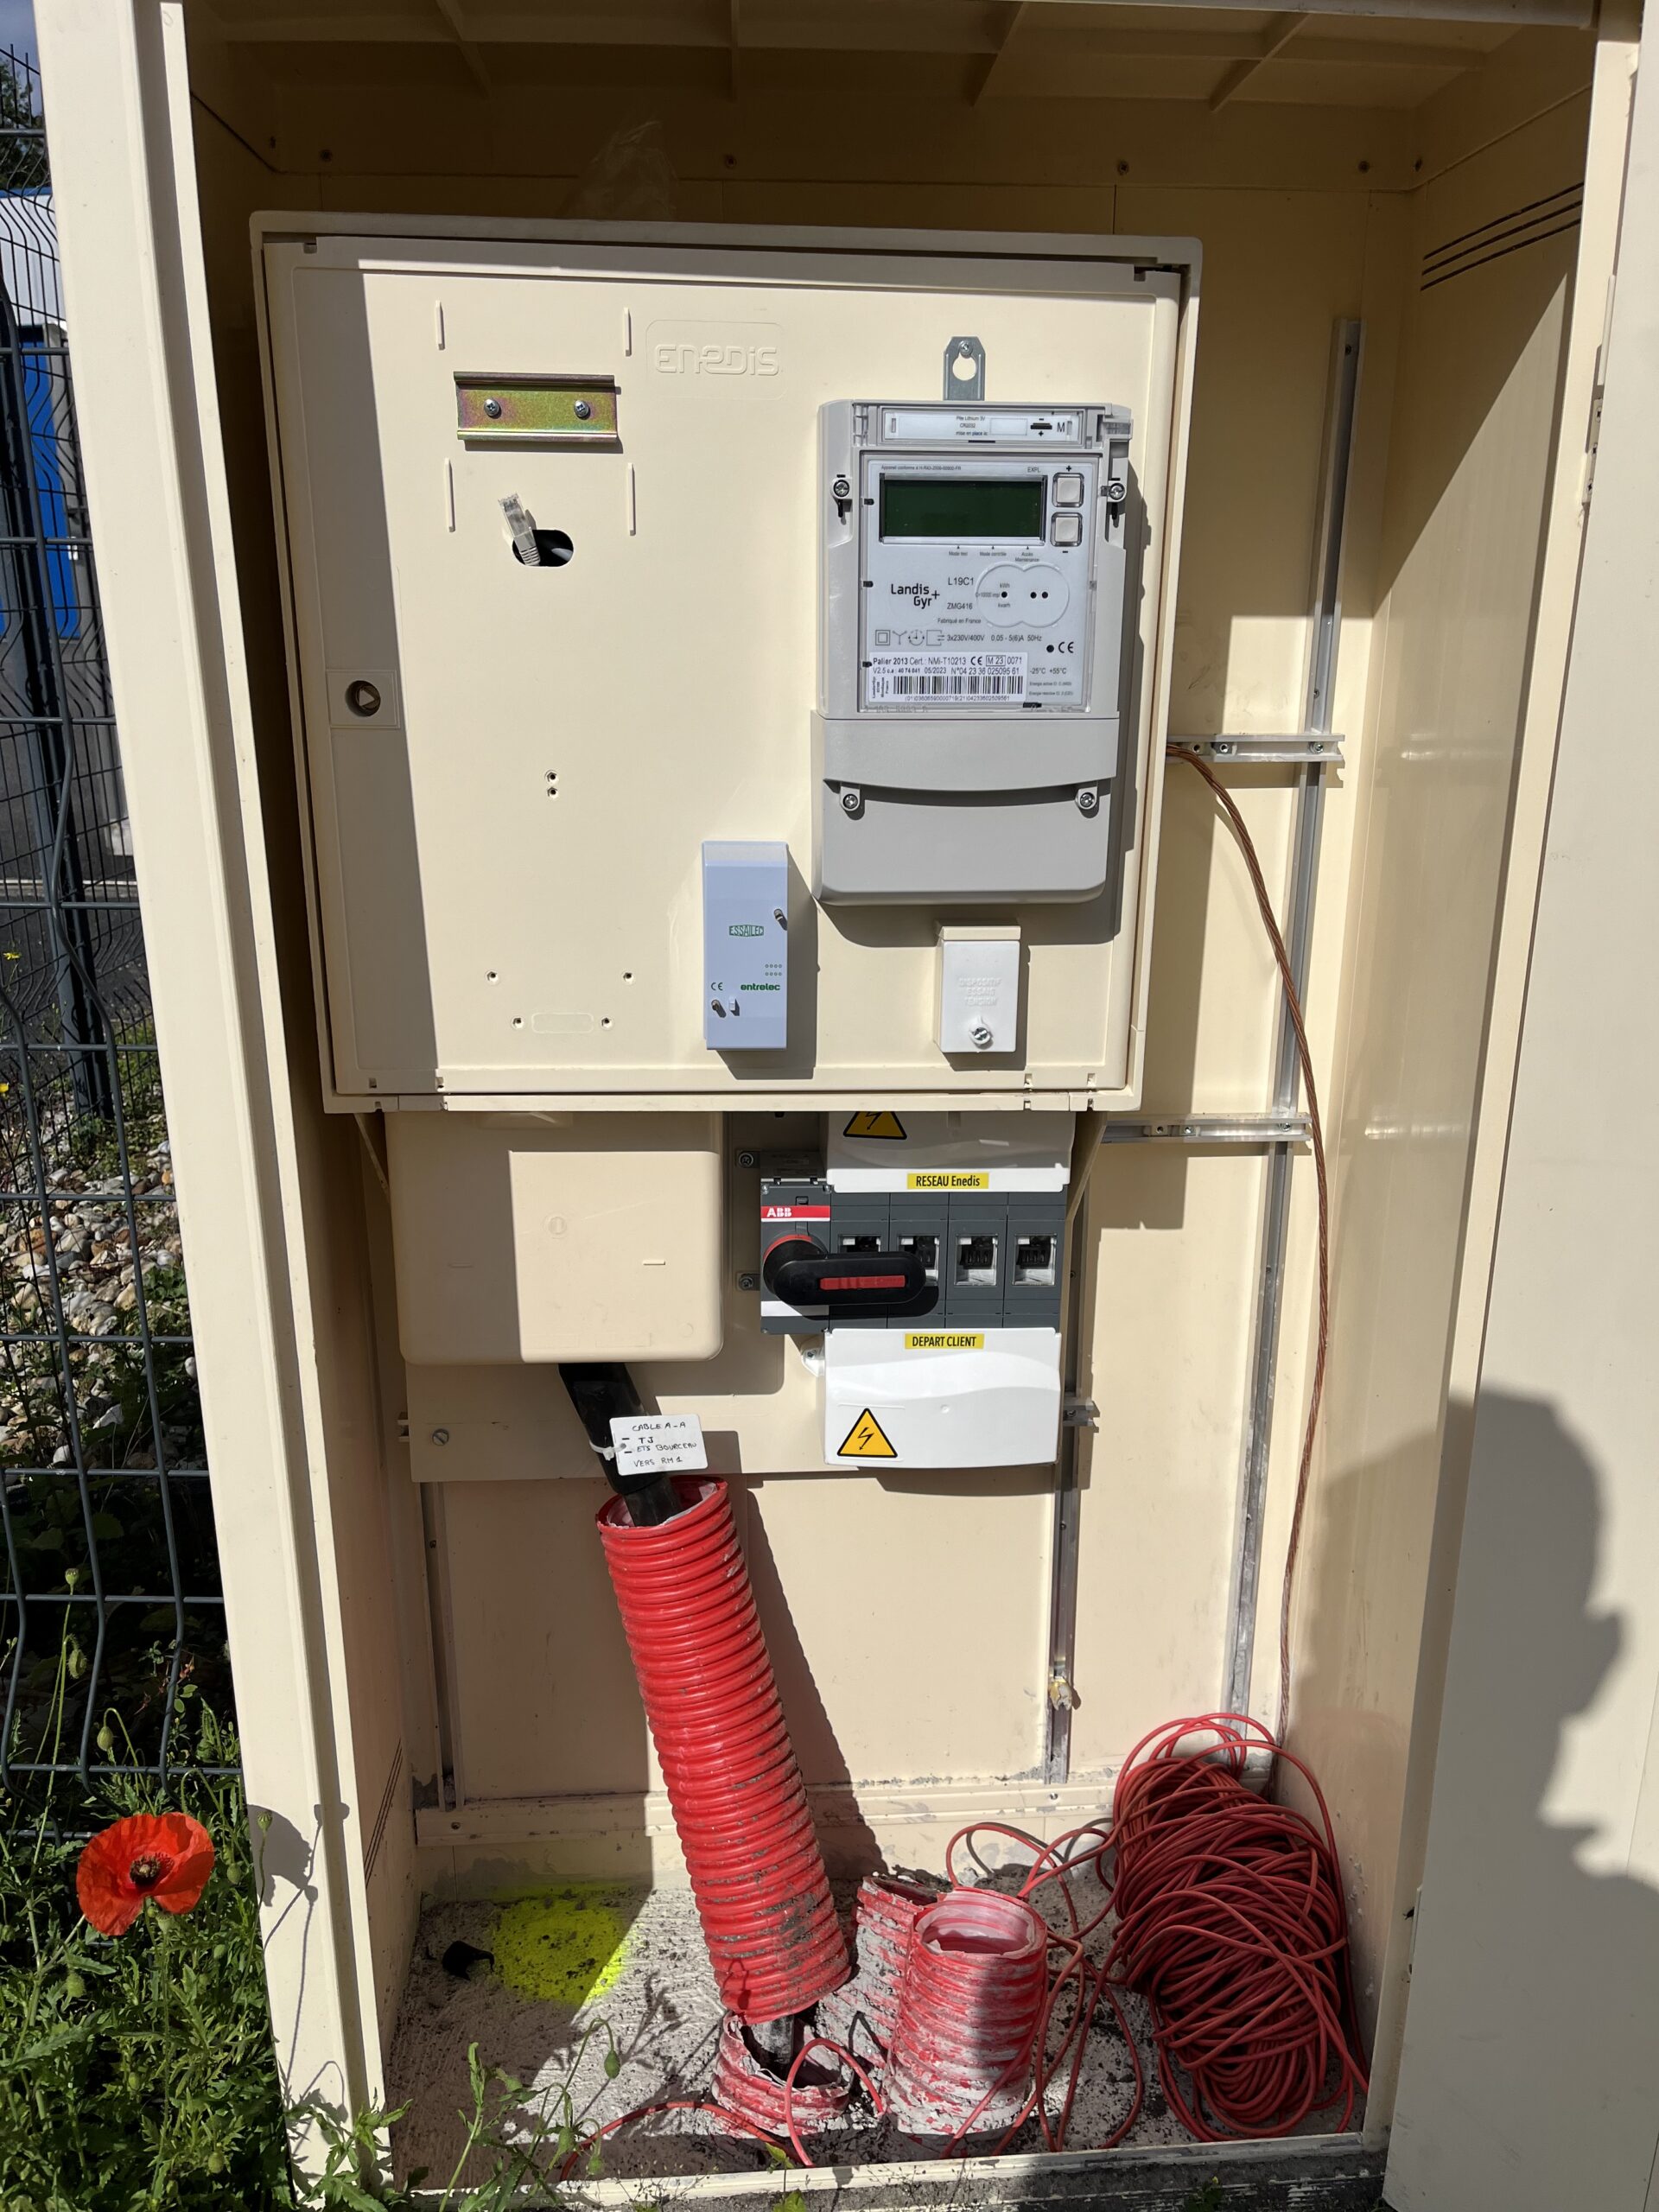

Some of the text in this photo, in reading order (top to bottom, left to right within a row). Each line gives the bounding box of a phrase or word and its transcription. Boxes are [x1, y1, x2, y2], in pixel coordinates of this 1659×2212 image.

[1057, 423, 1065, 432] M
[947, 577, 975, 586] L19C1
[891, 583, 930, 594] Landis
[913, 595, 932, 610] Gyr
[729, 925, 764, 937] ESSAILEC
[741, 982, 781, 991] entrelec
[916, 1174, 980, 1186] RESEAU Enedis
[766, 1207, 792, 1217] ABB
[912, 1336, 977, 1347] DEPART CLIENT
[632, 1423, 662, 1432] CABLE
[633, 1459, 654, 1468] VERS
